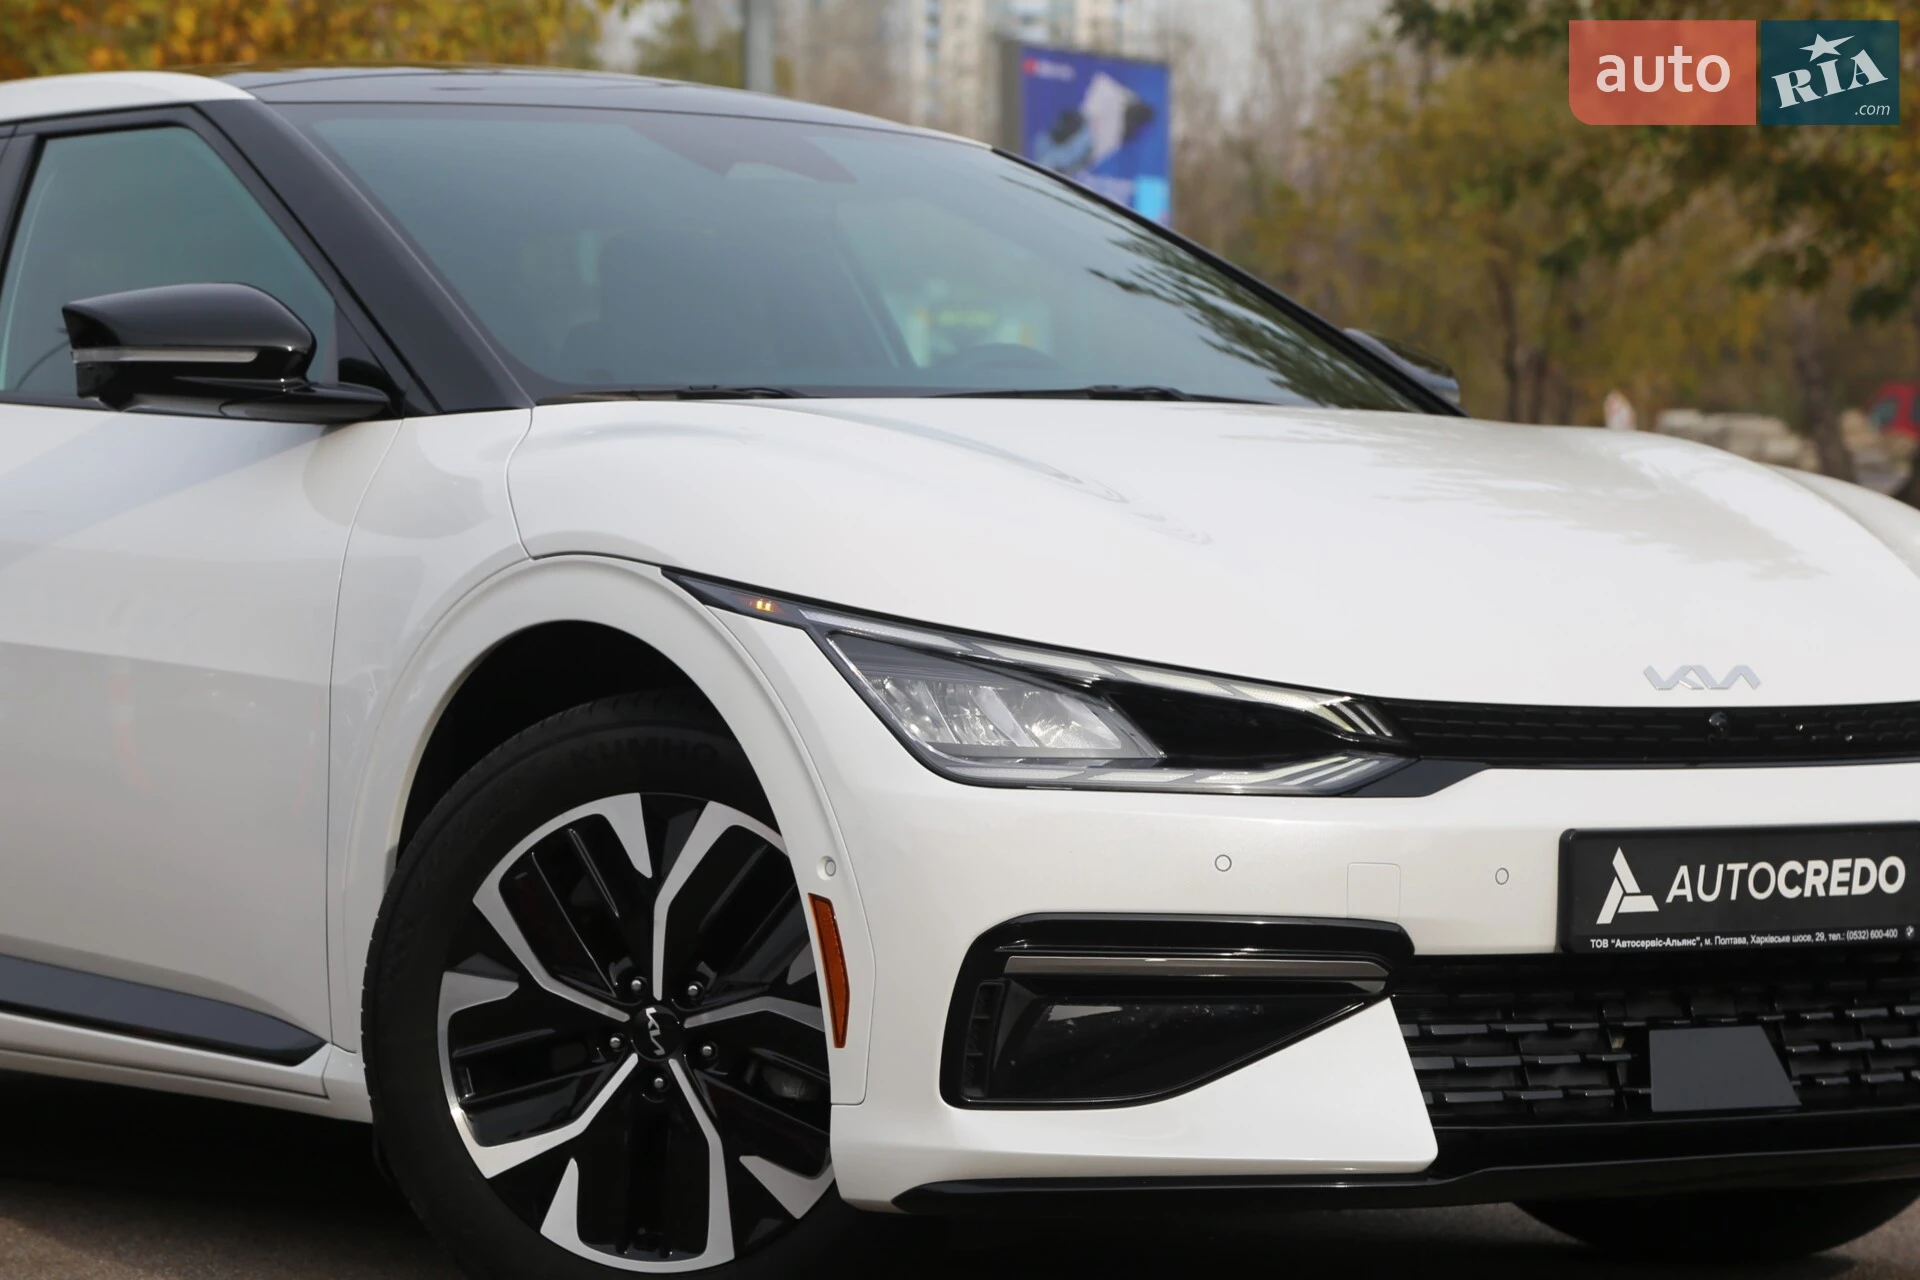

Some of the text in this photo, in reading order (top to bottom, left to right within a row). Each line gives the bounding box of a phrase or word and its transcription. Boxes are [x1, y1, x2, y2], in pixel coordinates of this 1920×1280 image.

[569, 736, 719, 768] KUMHO
[1665, 856, 1906, 903] AUTOCREDO
[1590, 938, 1609, 949] ТОВ
[1704, 938, 1713, 946] м.
[1714, 935, 1749, 947] Полтава,
[1750, 933, 1791, 946] Харківське
[1792, 935, 1814, 944] шосе,
[1815, 932, 1827, 943] 29,
[1828, 933, 1845, 942] тел.:
[1846, 929, 1869, 941] (0532)
[1870, 928, 1898, 940] 600-400
